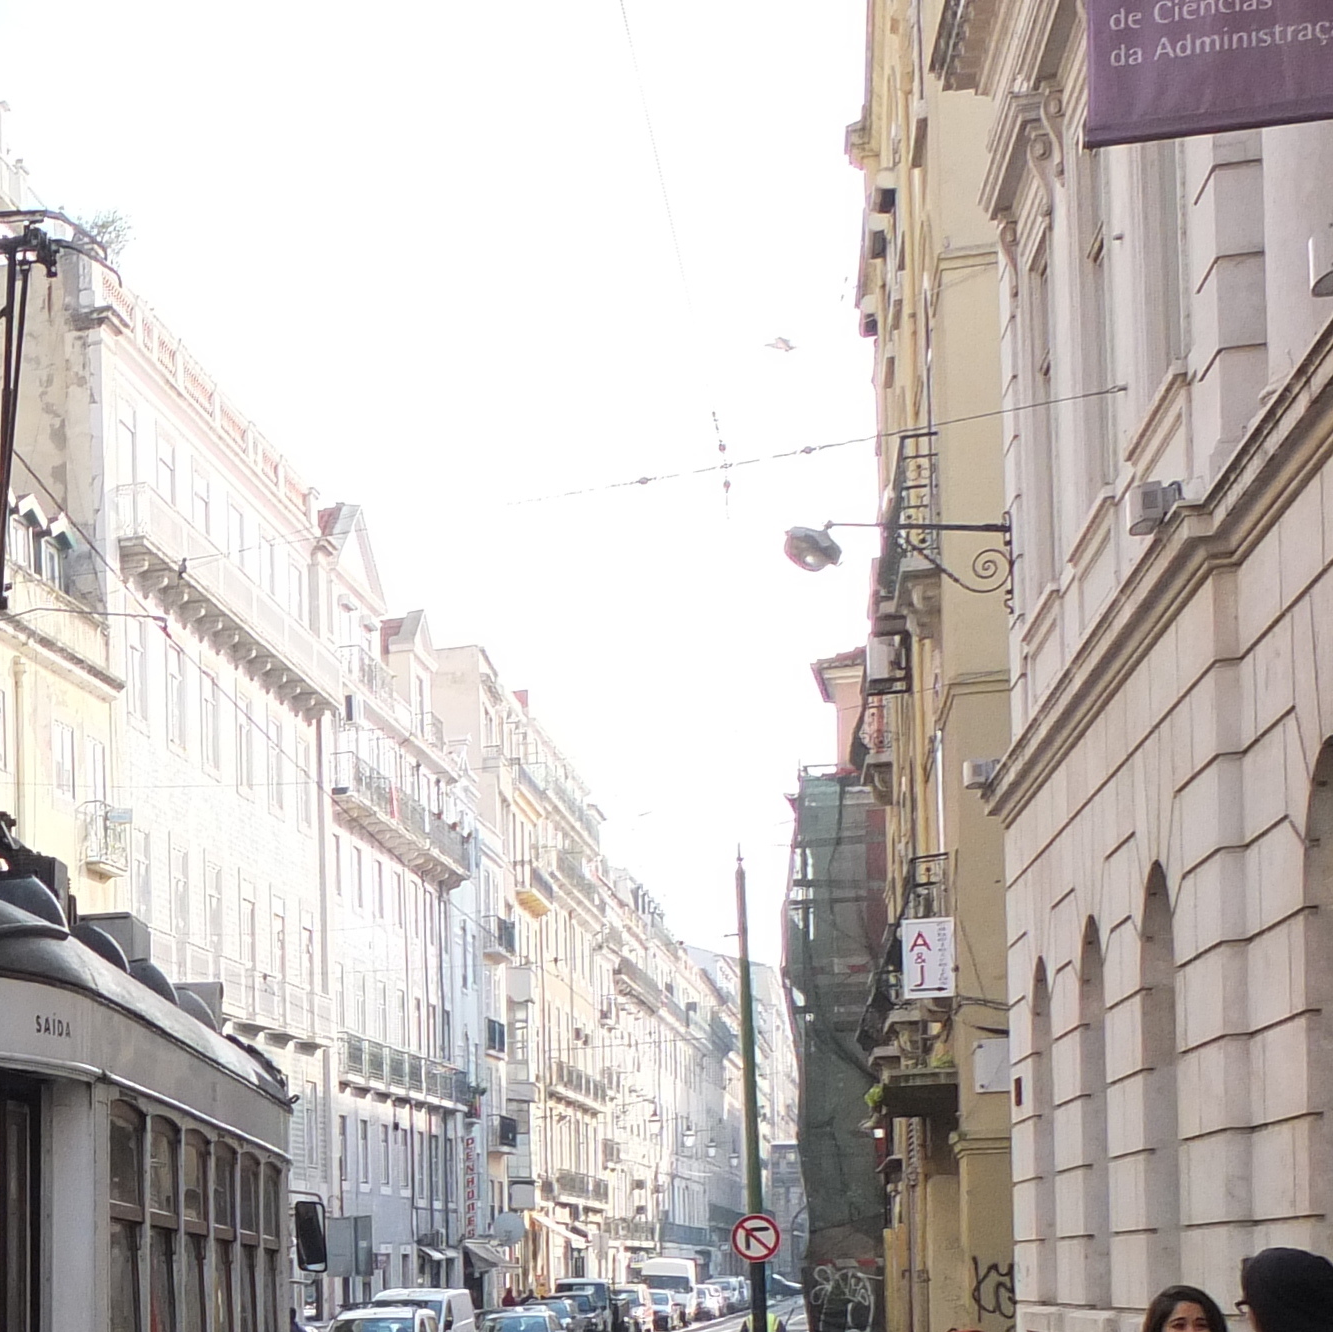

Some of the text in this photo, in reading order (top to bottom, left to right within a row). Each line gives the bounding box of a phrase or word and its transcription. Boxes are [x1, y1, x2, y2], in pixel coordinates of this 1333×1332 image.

[1109, 8, 1142, 31] de
[1110, 20, 1333, 67] da Administraç
[909, 930, 932, 953] A
[914, 952, 927, 965] &
[913, 965, 925, 987] J
